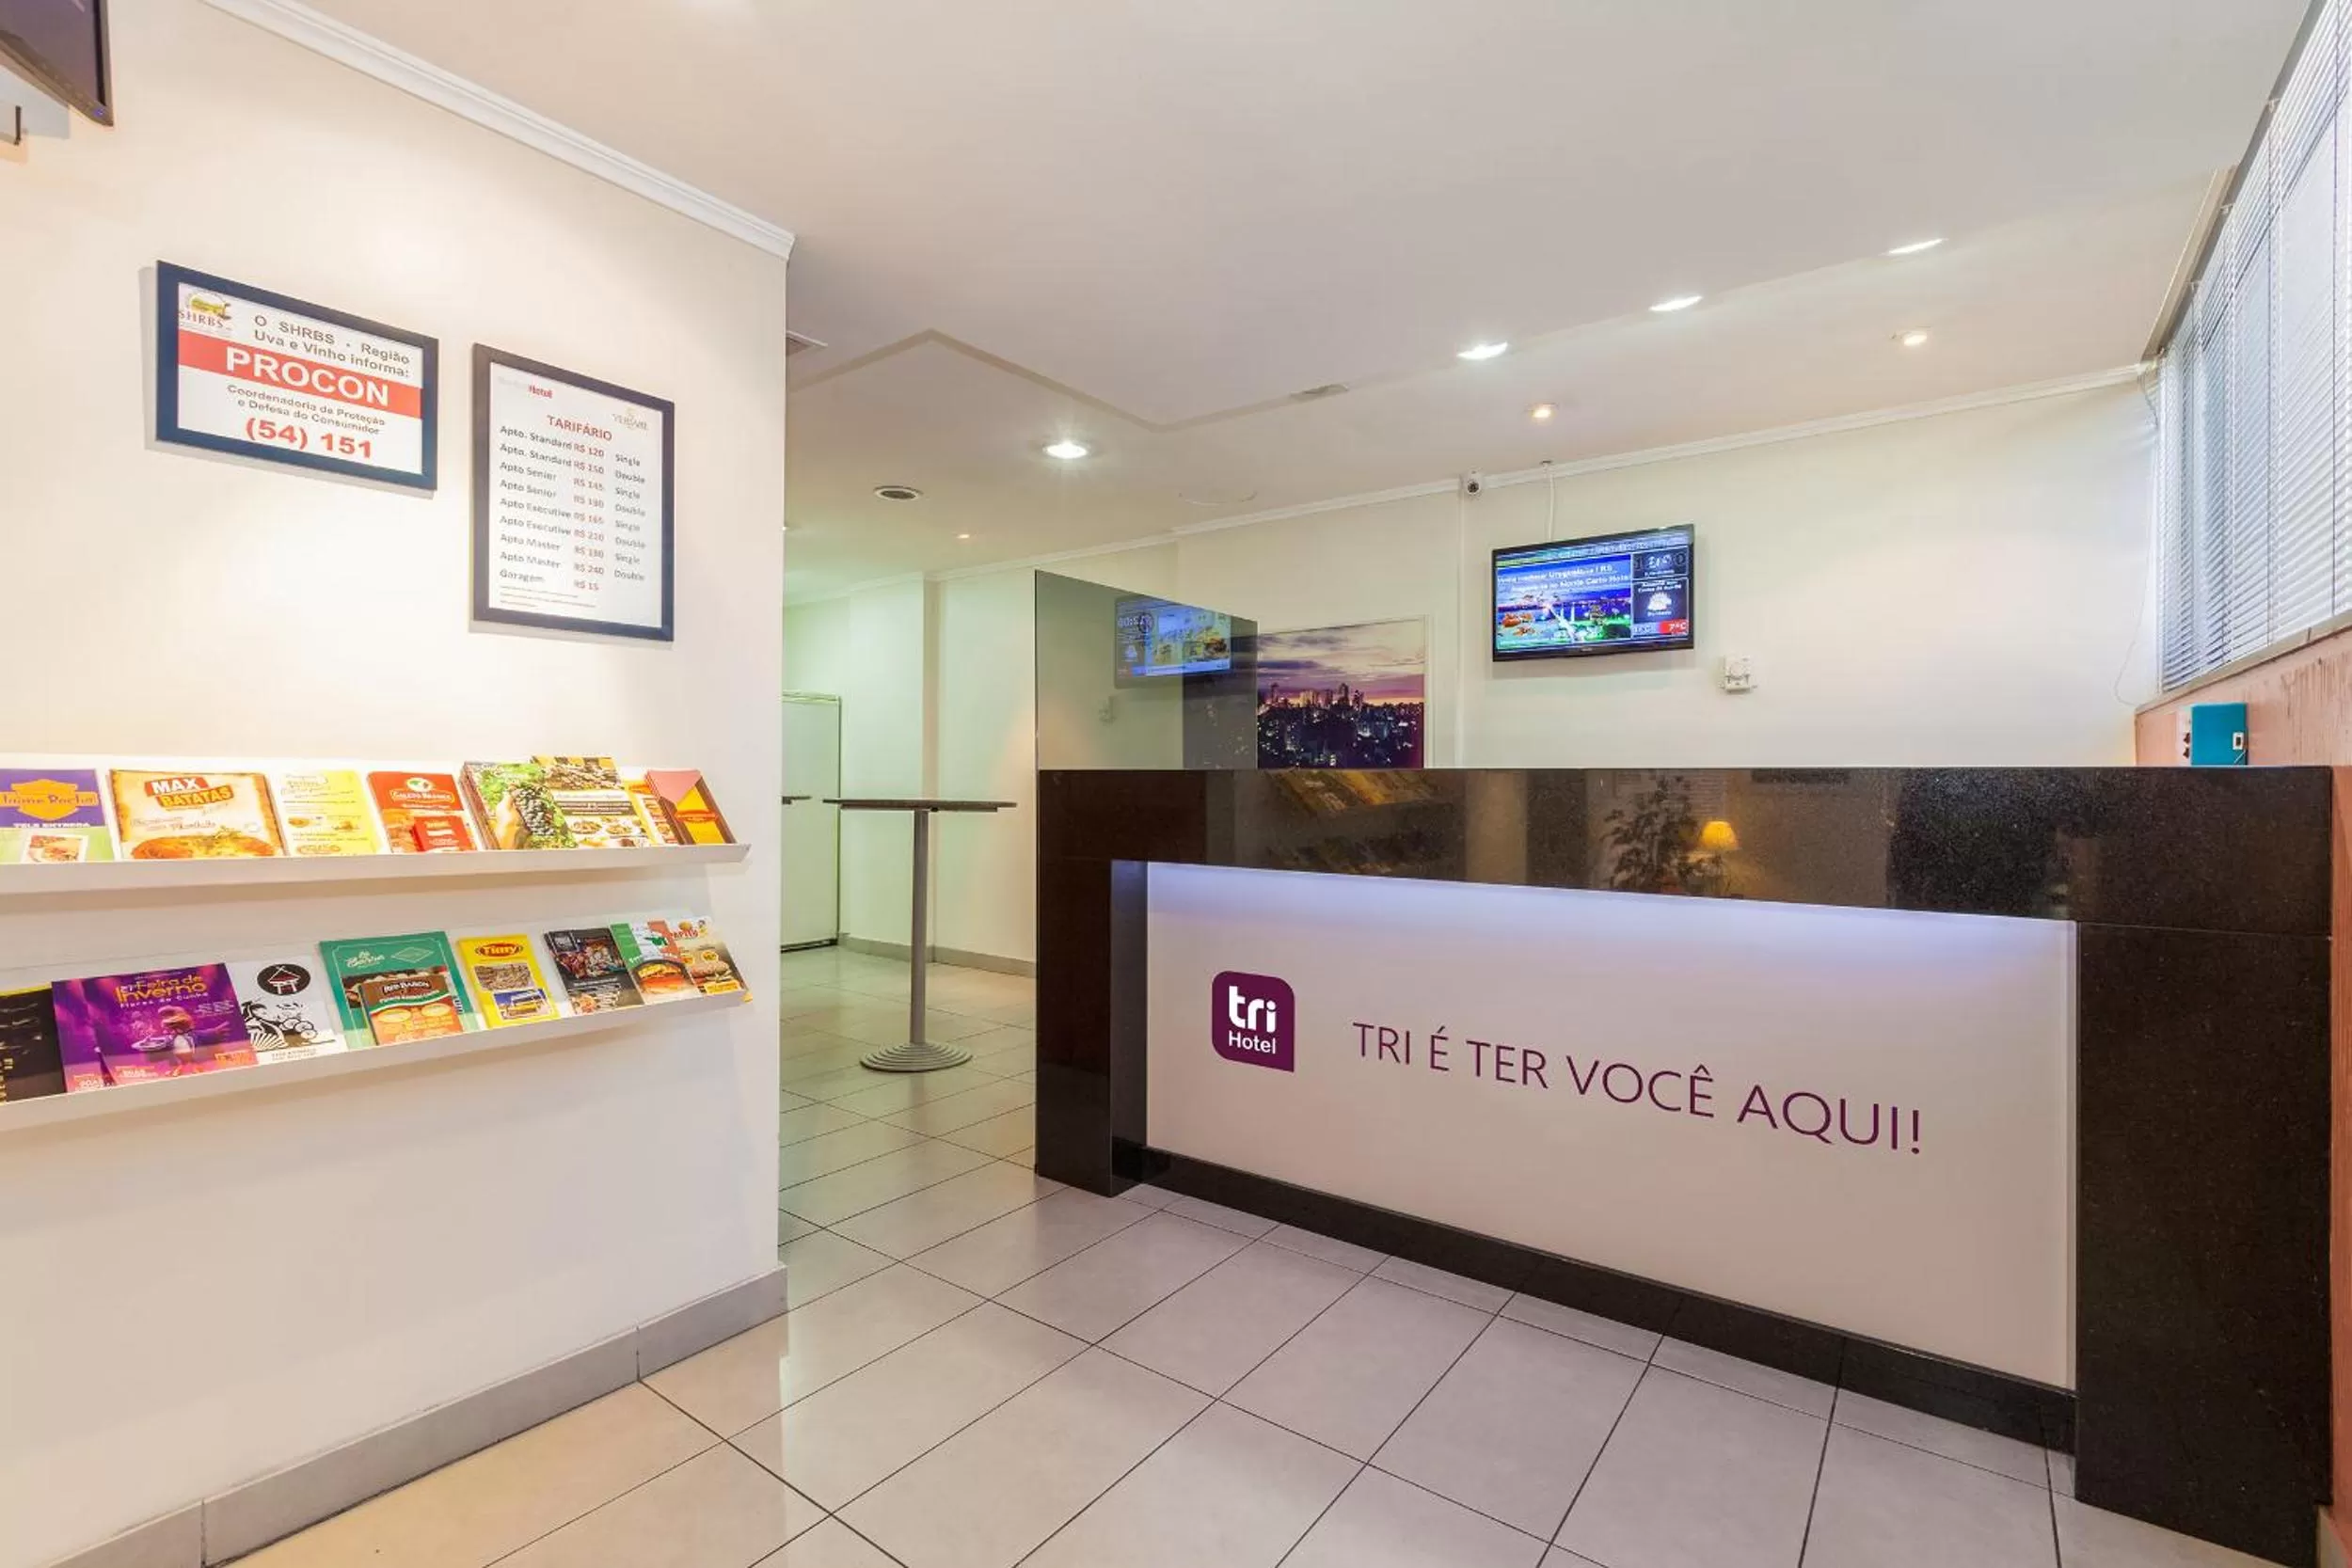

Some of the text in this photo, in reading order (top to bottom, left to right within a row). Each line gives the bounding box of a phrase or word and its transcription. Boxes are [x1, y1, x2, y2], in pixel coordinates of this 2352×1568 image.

[179, 310, 224, 328] SHRBS
[255, 315, 267, 326] O
[278, 322, 335, 344] SHRBS
[361, 343, 409, 365] Região
[254, 330, 409, 377] Uva e Vinho informa:
[226, 347, 389, 406] PROCON
[228, 385, 316, 410] Coordenadoria
[337, 408, 385, 426] Proteção
[249, 399, 290, 416] Defesa
[294, 409, 309, 420] do
[311, 413, 380, 436] Consumidor
[547, 415, 612, 441] TARIFÁRIO
[246, 418, 371, 458] (54) 151
[500, 426, 527, 439] Apto.
[530, 433, 572, 450] Standard
[500, 443, 527, 457] Apto.
[530, 450, 572, 467] Standard
[527, 467, 557, 482] Senior
[527, 485, 557, 498] Senior
[527, 538, 561, 552] Master
[527, 556, 562, 569] Master
[500, 568, 545, 583] Garagem
[151, 778, 199, 794] MAX
[161, 786, 231, 807] BATATAS
[115, 982, 208, 1003] Inverno
[136, 978, 180, 990] Feira
[182, 974, 203, 985] de
[1229, 985, 1277, 1034] tri
[1228, 1031, 1277, 1054] Hotel
[1353, 1022, 1920, 1155] TRI É TER VOCÊ AQUI!
